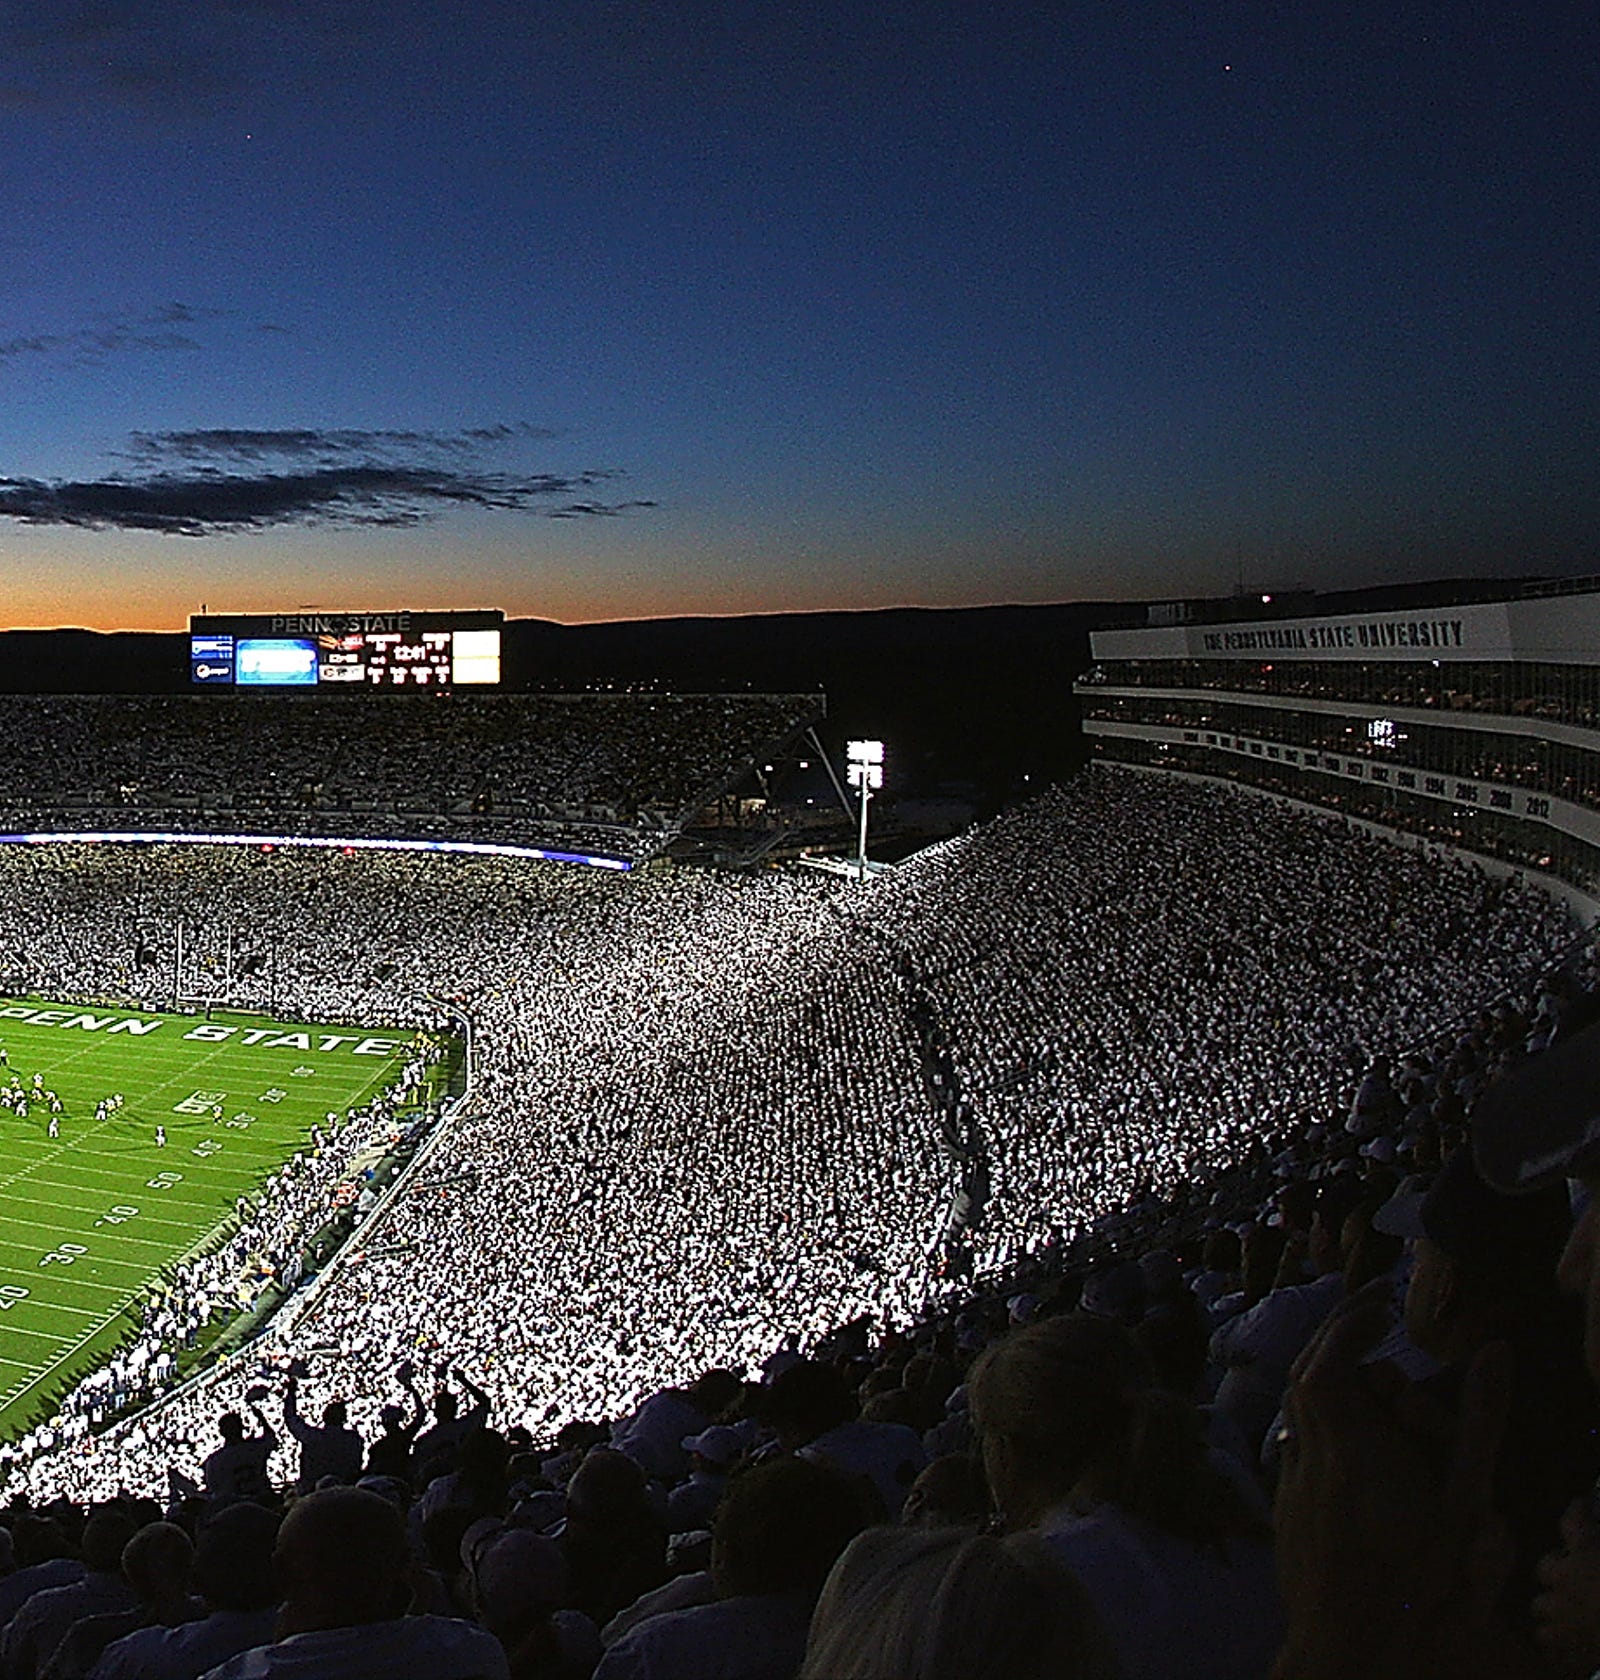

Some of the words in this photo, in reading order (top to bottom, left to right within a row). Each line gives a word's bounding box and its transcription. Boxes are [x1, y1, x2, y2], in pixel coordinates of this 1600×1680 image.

[272, 617, 328, 633] PENN
[348, 615, 411, 632] STATE
[1309, 625, 1353, 648] STATE
[1357, 619, 1464, 648] UNIVERSITY
[1527, 796, 1549, 819] 2012
[183, 1024, 404, 1056] STATE
[146, 1171, 183, 1190] 50
[103, 1205, 140, 1225] 40
[47, 1243, 89, 1266] 30
